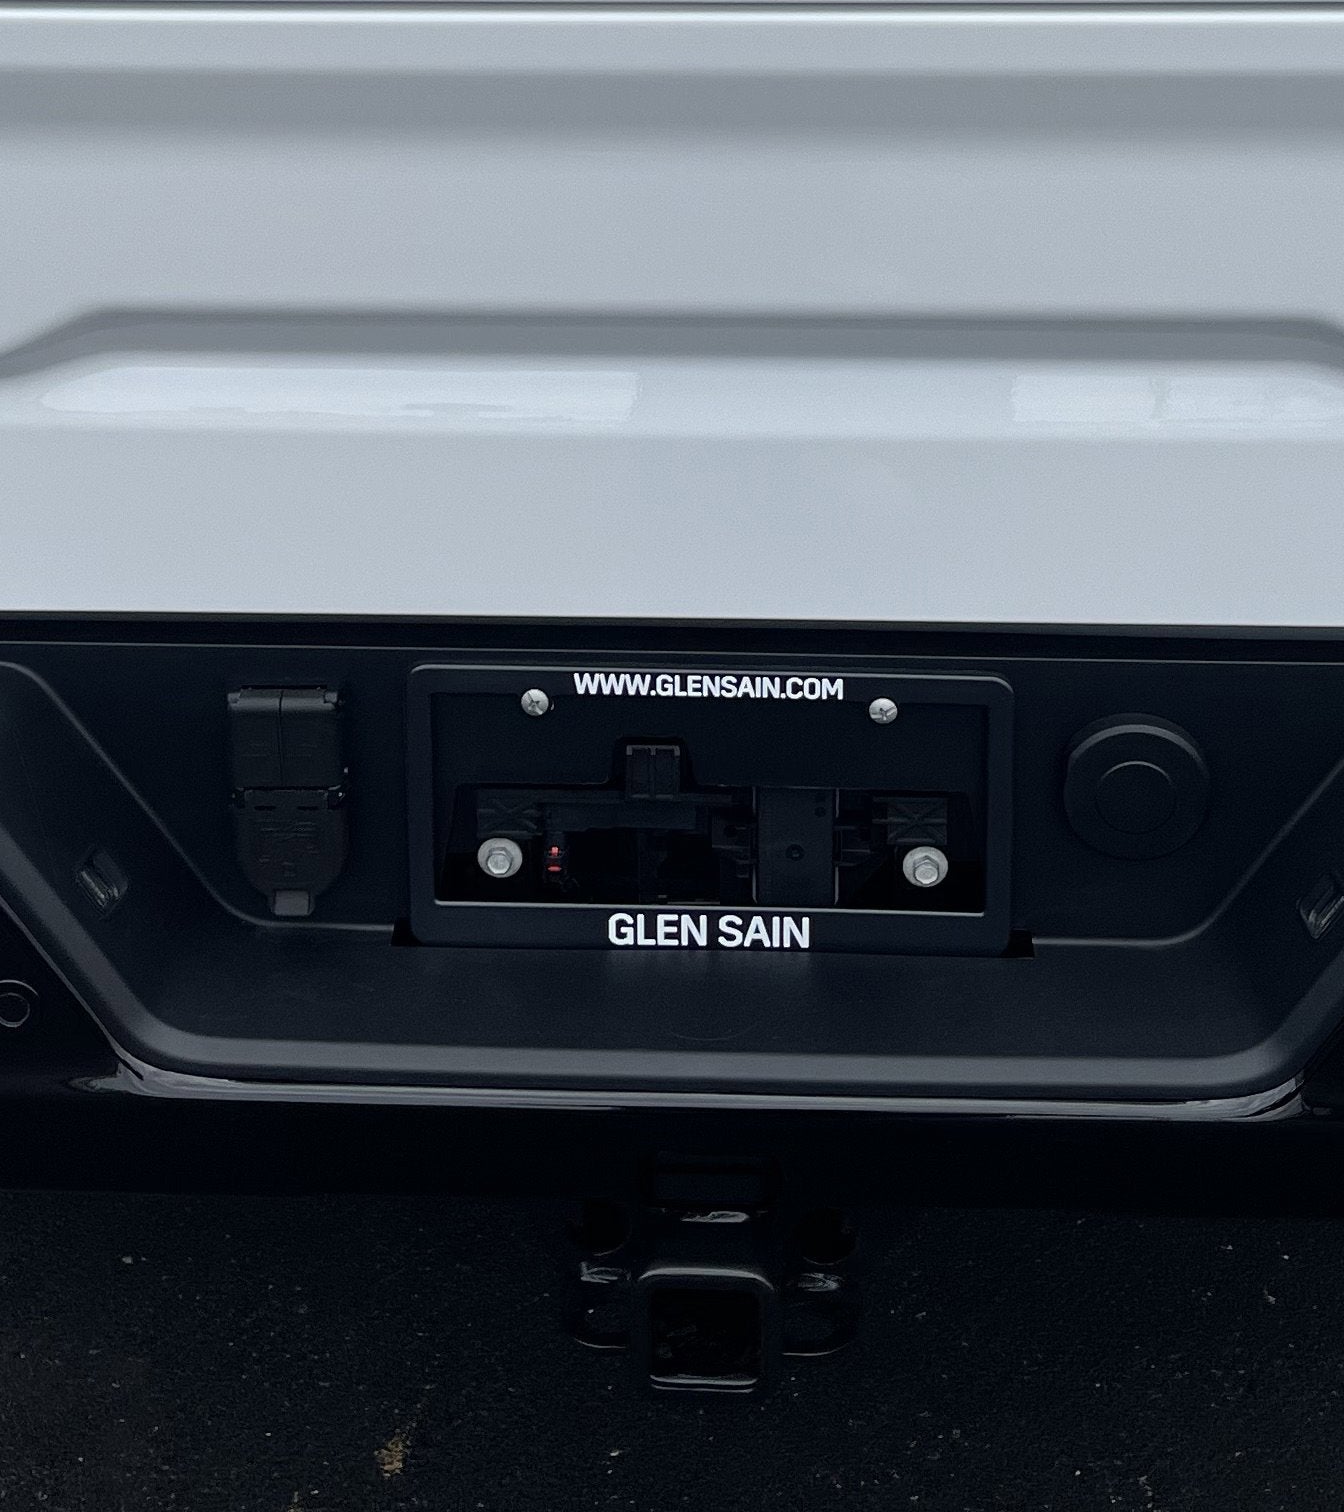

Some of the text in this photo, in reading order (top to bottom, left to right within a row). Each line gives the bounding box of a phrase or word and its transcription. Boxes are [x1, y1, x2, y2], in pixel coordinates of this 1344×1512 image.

[573, 672, 844, 700] WWW.GLENSAIN.COM
[608, 912, 810, 949] GLEN SAIN
